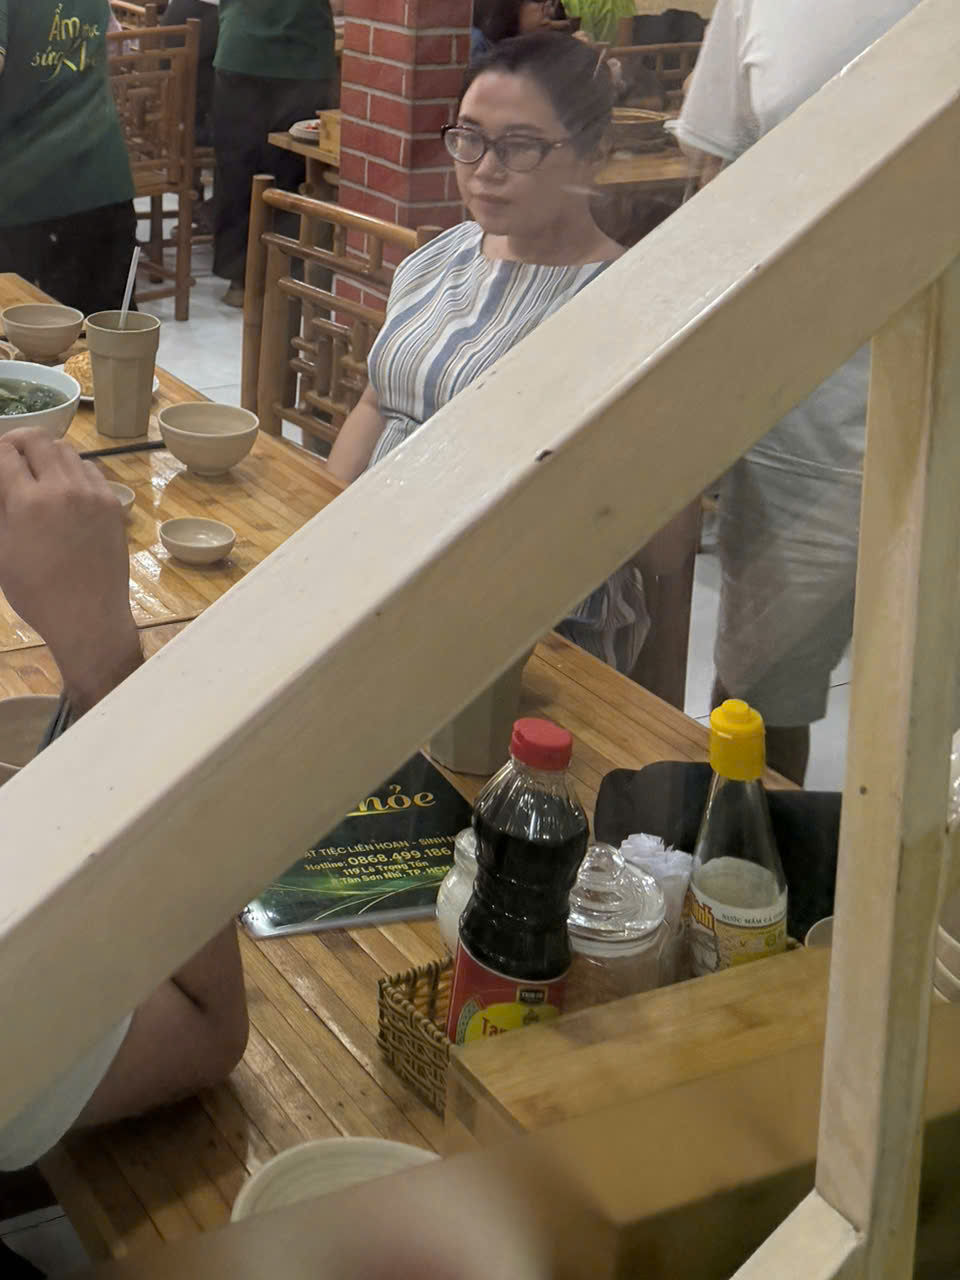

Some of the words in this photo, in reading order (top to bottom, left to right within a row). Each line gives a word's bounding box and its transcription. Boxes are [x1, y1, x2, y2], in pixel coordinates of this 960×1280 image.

[319, 846, 347, 857] TIỆC
[348, 842, 375, 854] LIÊN
[376, 840, 409, 851] HOAN
[348, 846, 451, 866] 0868.499.186
